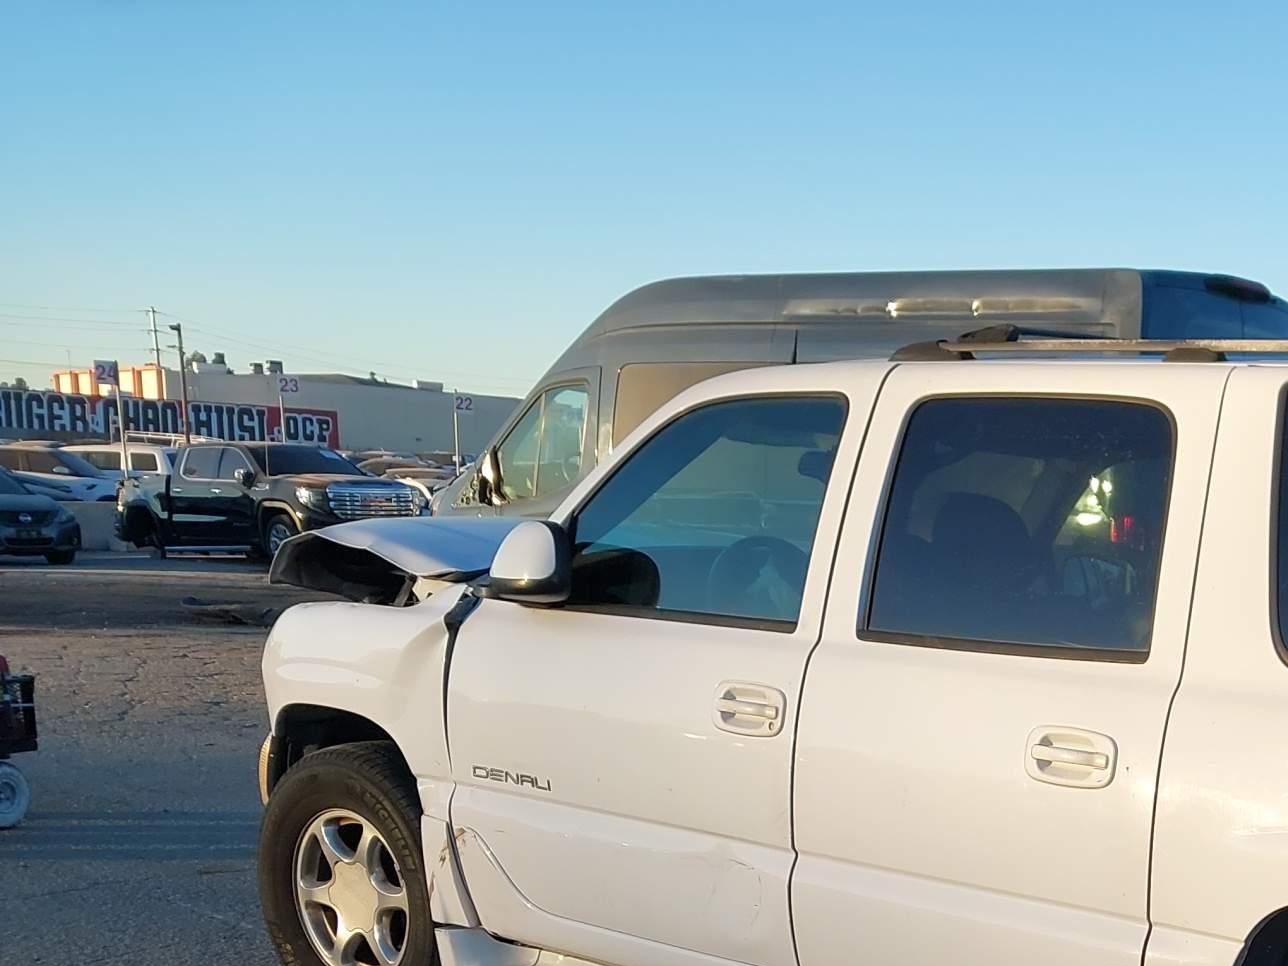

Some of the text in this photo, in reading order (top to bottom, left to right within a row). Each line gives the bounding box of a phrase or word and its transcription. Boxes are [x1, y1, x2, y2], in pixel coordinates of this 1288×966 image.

[279, 377, 299, 394] 23
[455, 396, 473, 411] 22
[472, 765, 552, 792] DENALI
